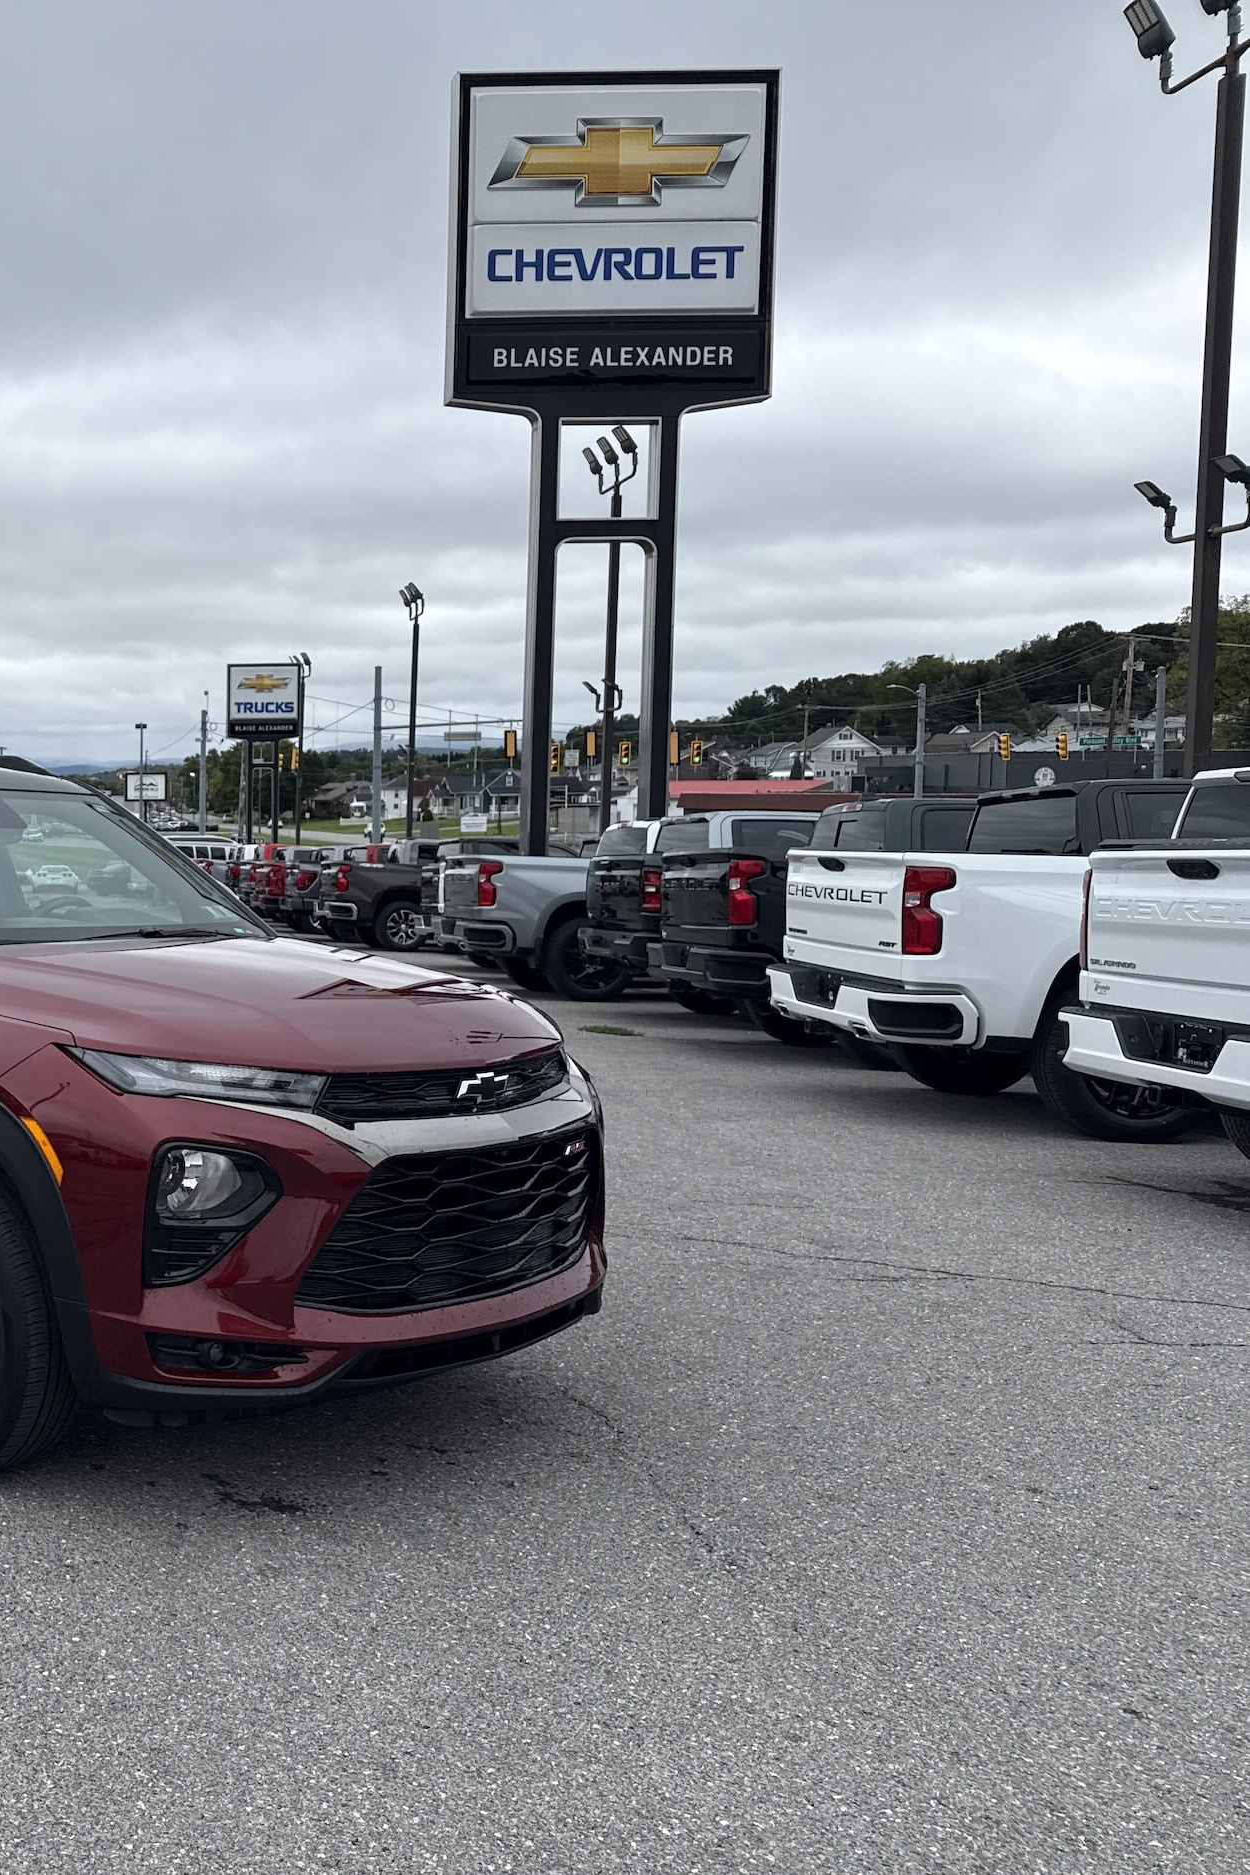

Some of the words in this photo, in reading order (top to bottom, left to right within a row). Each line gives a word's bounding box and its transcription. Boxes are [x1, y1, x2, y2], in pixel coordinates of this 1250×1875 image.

[487, 245, 744, 283] CHEVROLET
[493, 347, 579, 369] BLAISE
[589, 345, 734, 367] ALEXANDER
[234, 701, 295, 713] TRUCKS
[788, 883, 888, 905] CHEVROLET
[878, 940, 897, 948] RST
